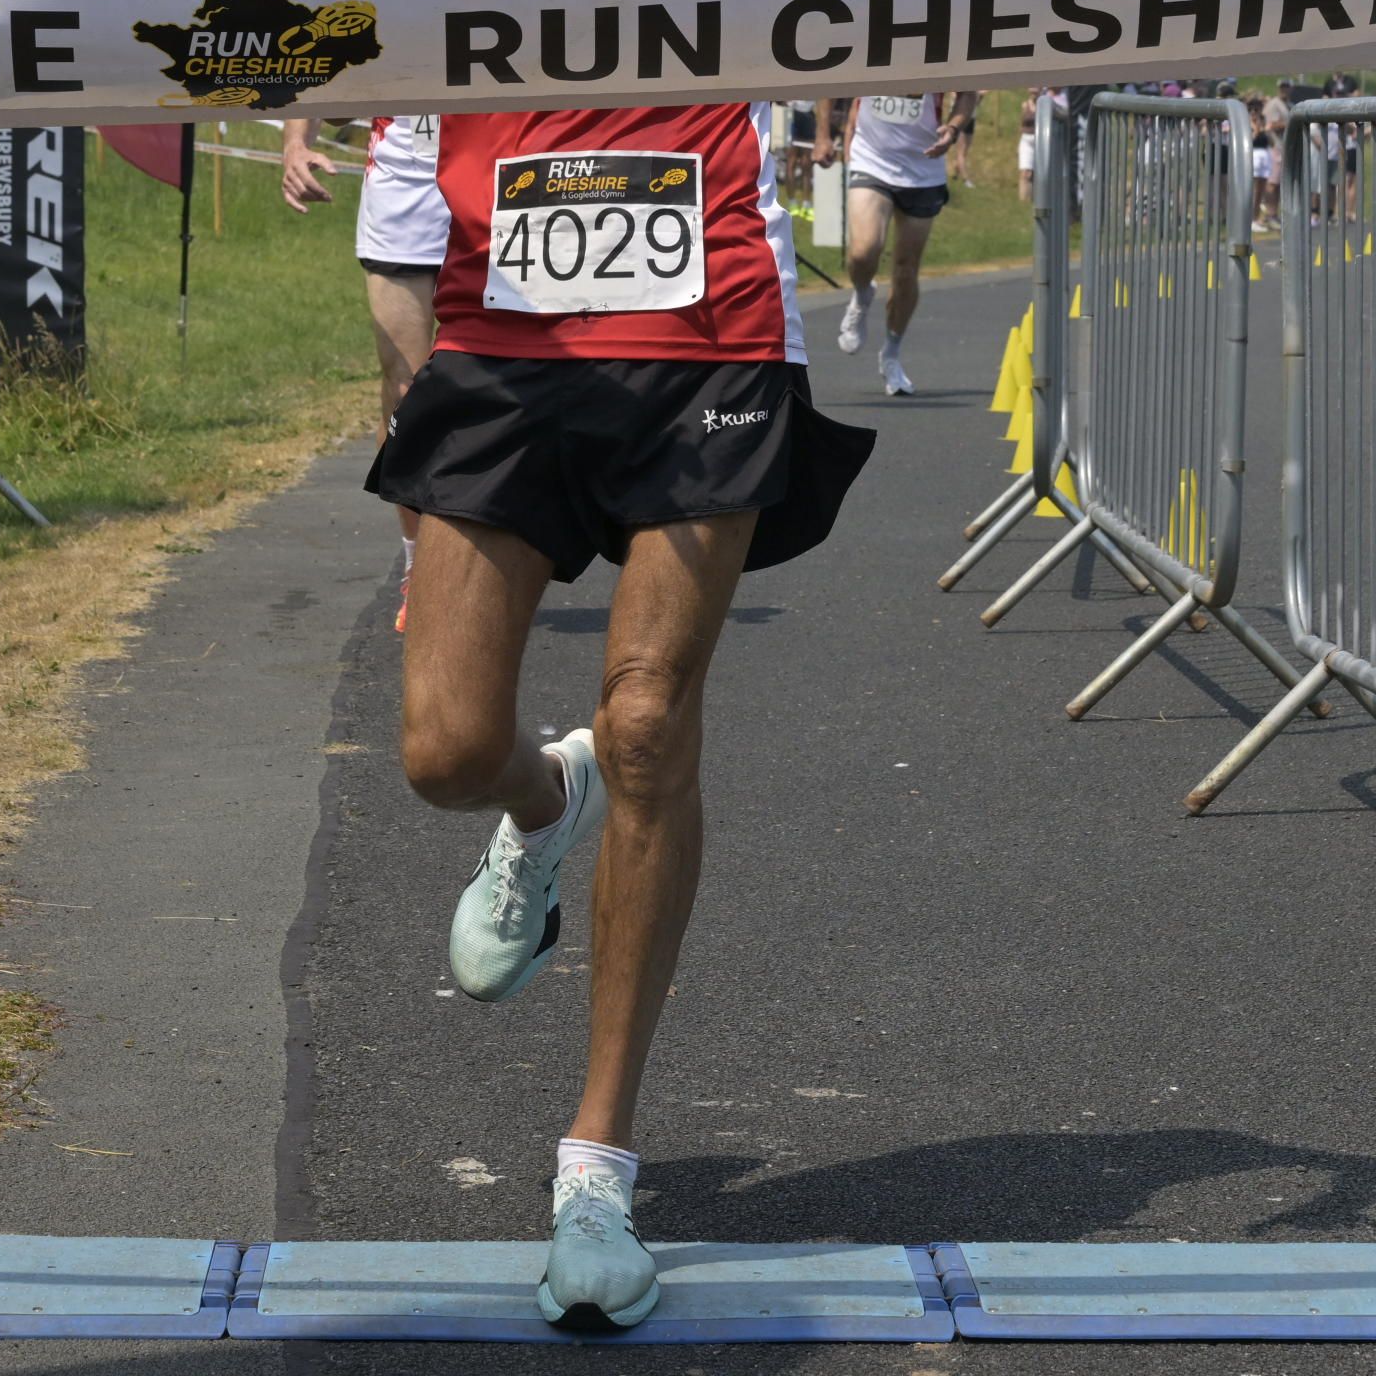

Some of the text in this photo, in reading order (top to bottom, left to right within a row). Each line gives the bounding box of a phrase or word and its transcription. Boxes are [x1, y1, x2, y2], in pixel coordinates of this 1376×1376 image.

[188, 31, 271, 57] RUN
[445, 0, 722, 86] RUN
[185, 57, 332, 75] CHESHIRE
[214, 74, 328, 86] & Gogledd Cymru
[548, 160, 594, 178] RUN
[546, 176, 628, 193] CHESHIRE
[561, 190, 625, 200] & Gogledd Cymru
[26, 126, 64, 319] REK
[497, 207, 691, 282] 4029
[721, 409, 768, 427] KUKRI
